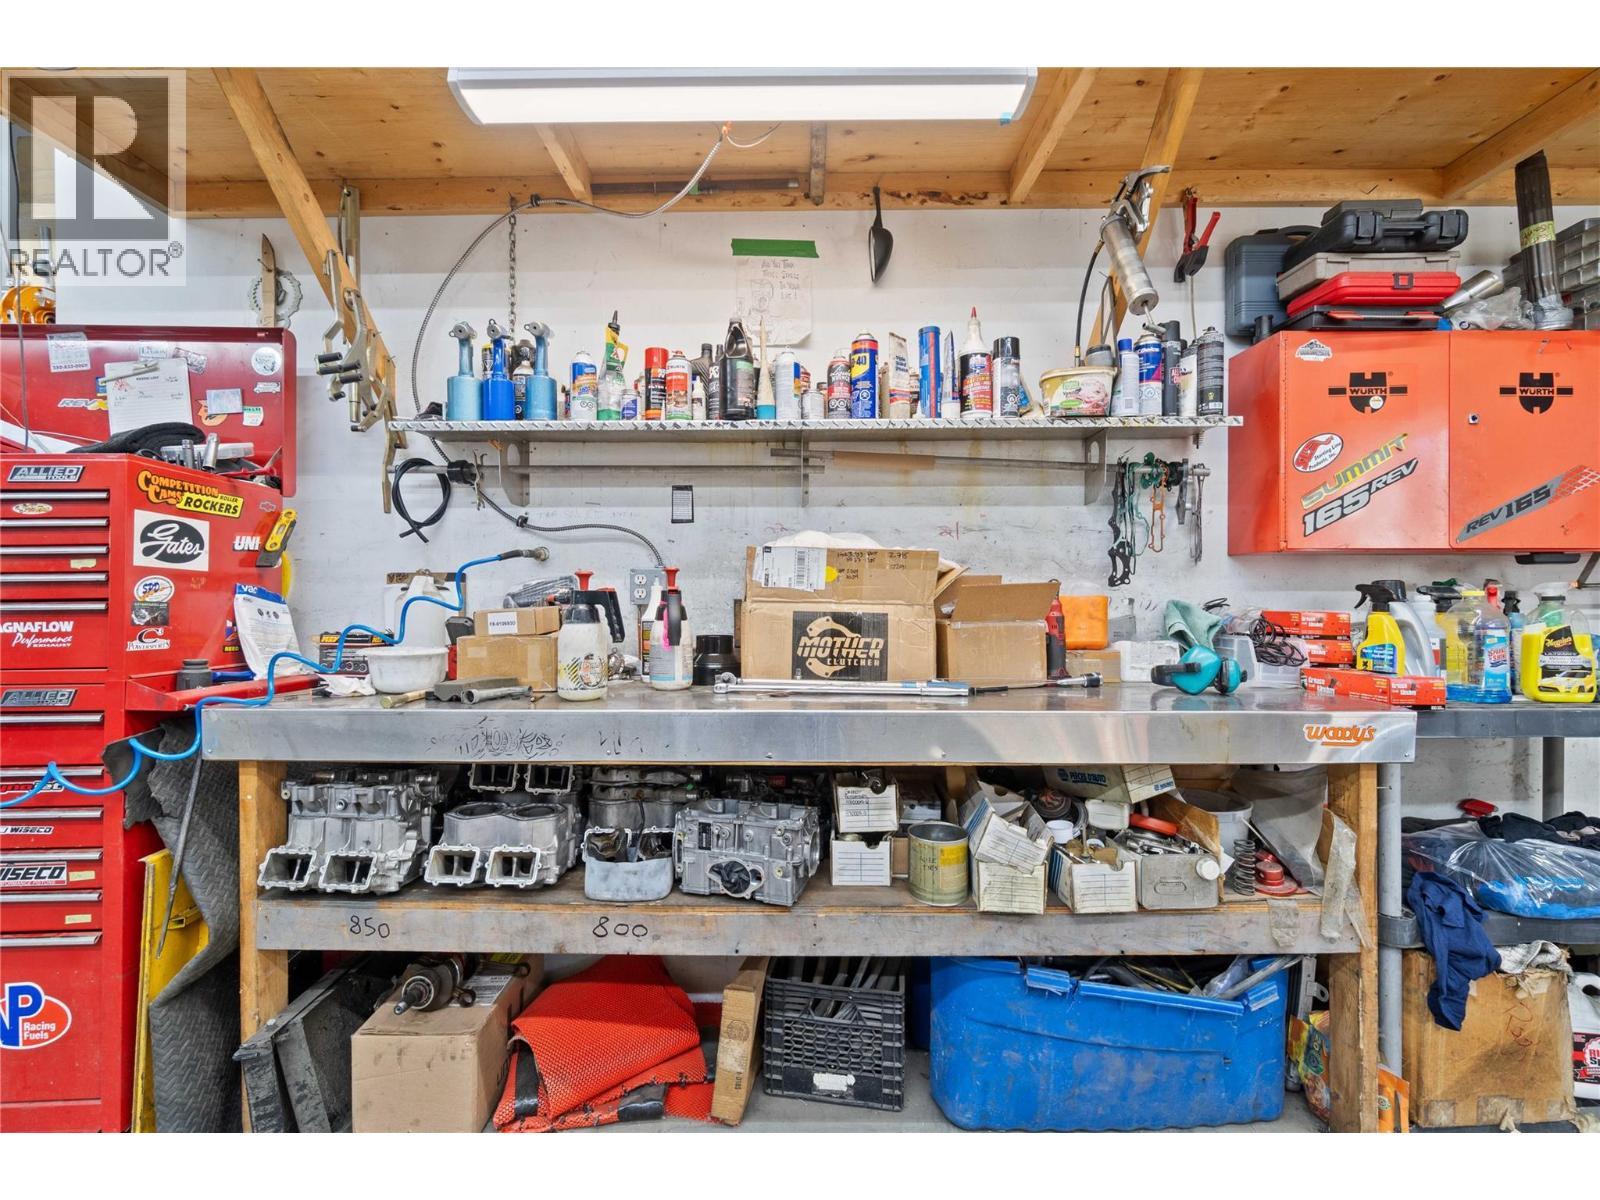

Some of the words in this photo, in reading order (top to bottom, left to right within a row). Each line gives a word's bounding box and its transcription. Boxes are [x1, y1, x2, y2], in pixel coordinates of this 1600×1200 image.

[16, 467, 78, 477] ALLIED
[1301, 433, 1408, 509] SUMMIT
[138, 470, 219, 498] COMPETITION
[148, 484, 183, 505] CAMS
[183, 496, 239, 515] ROCKERS
[142, 523, 204, 560] Gates
[796, 636, 885, 659] MOTHER
[827, 658, 880, 667] CLUTCHER
[10, 826, 53, 834] WISECO
[350, 915, 391, 938] 850
[592, 916, 648, 938] 800
[23, 1021, 56, 1032] Racing
[23, 1031, 49, 1041] Fuels
